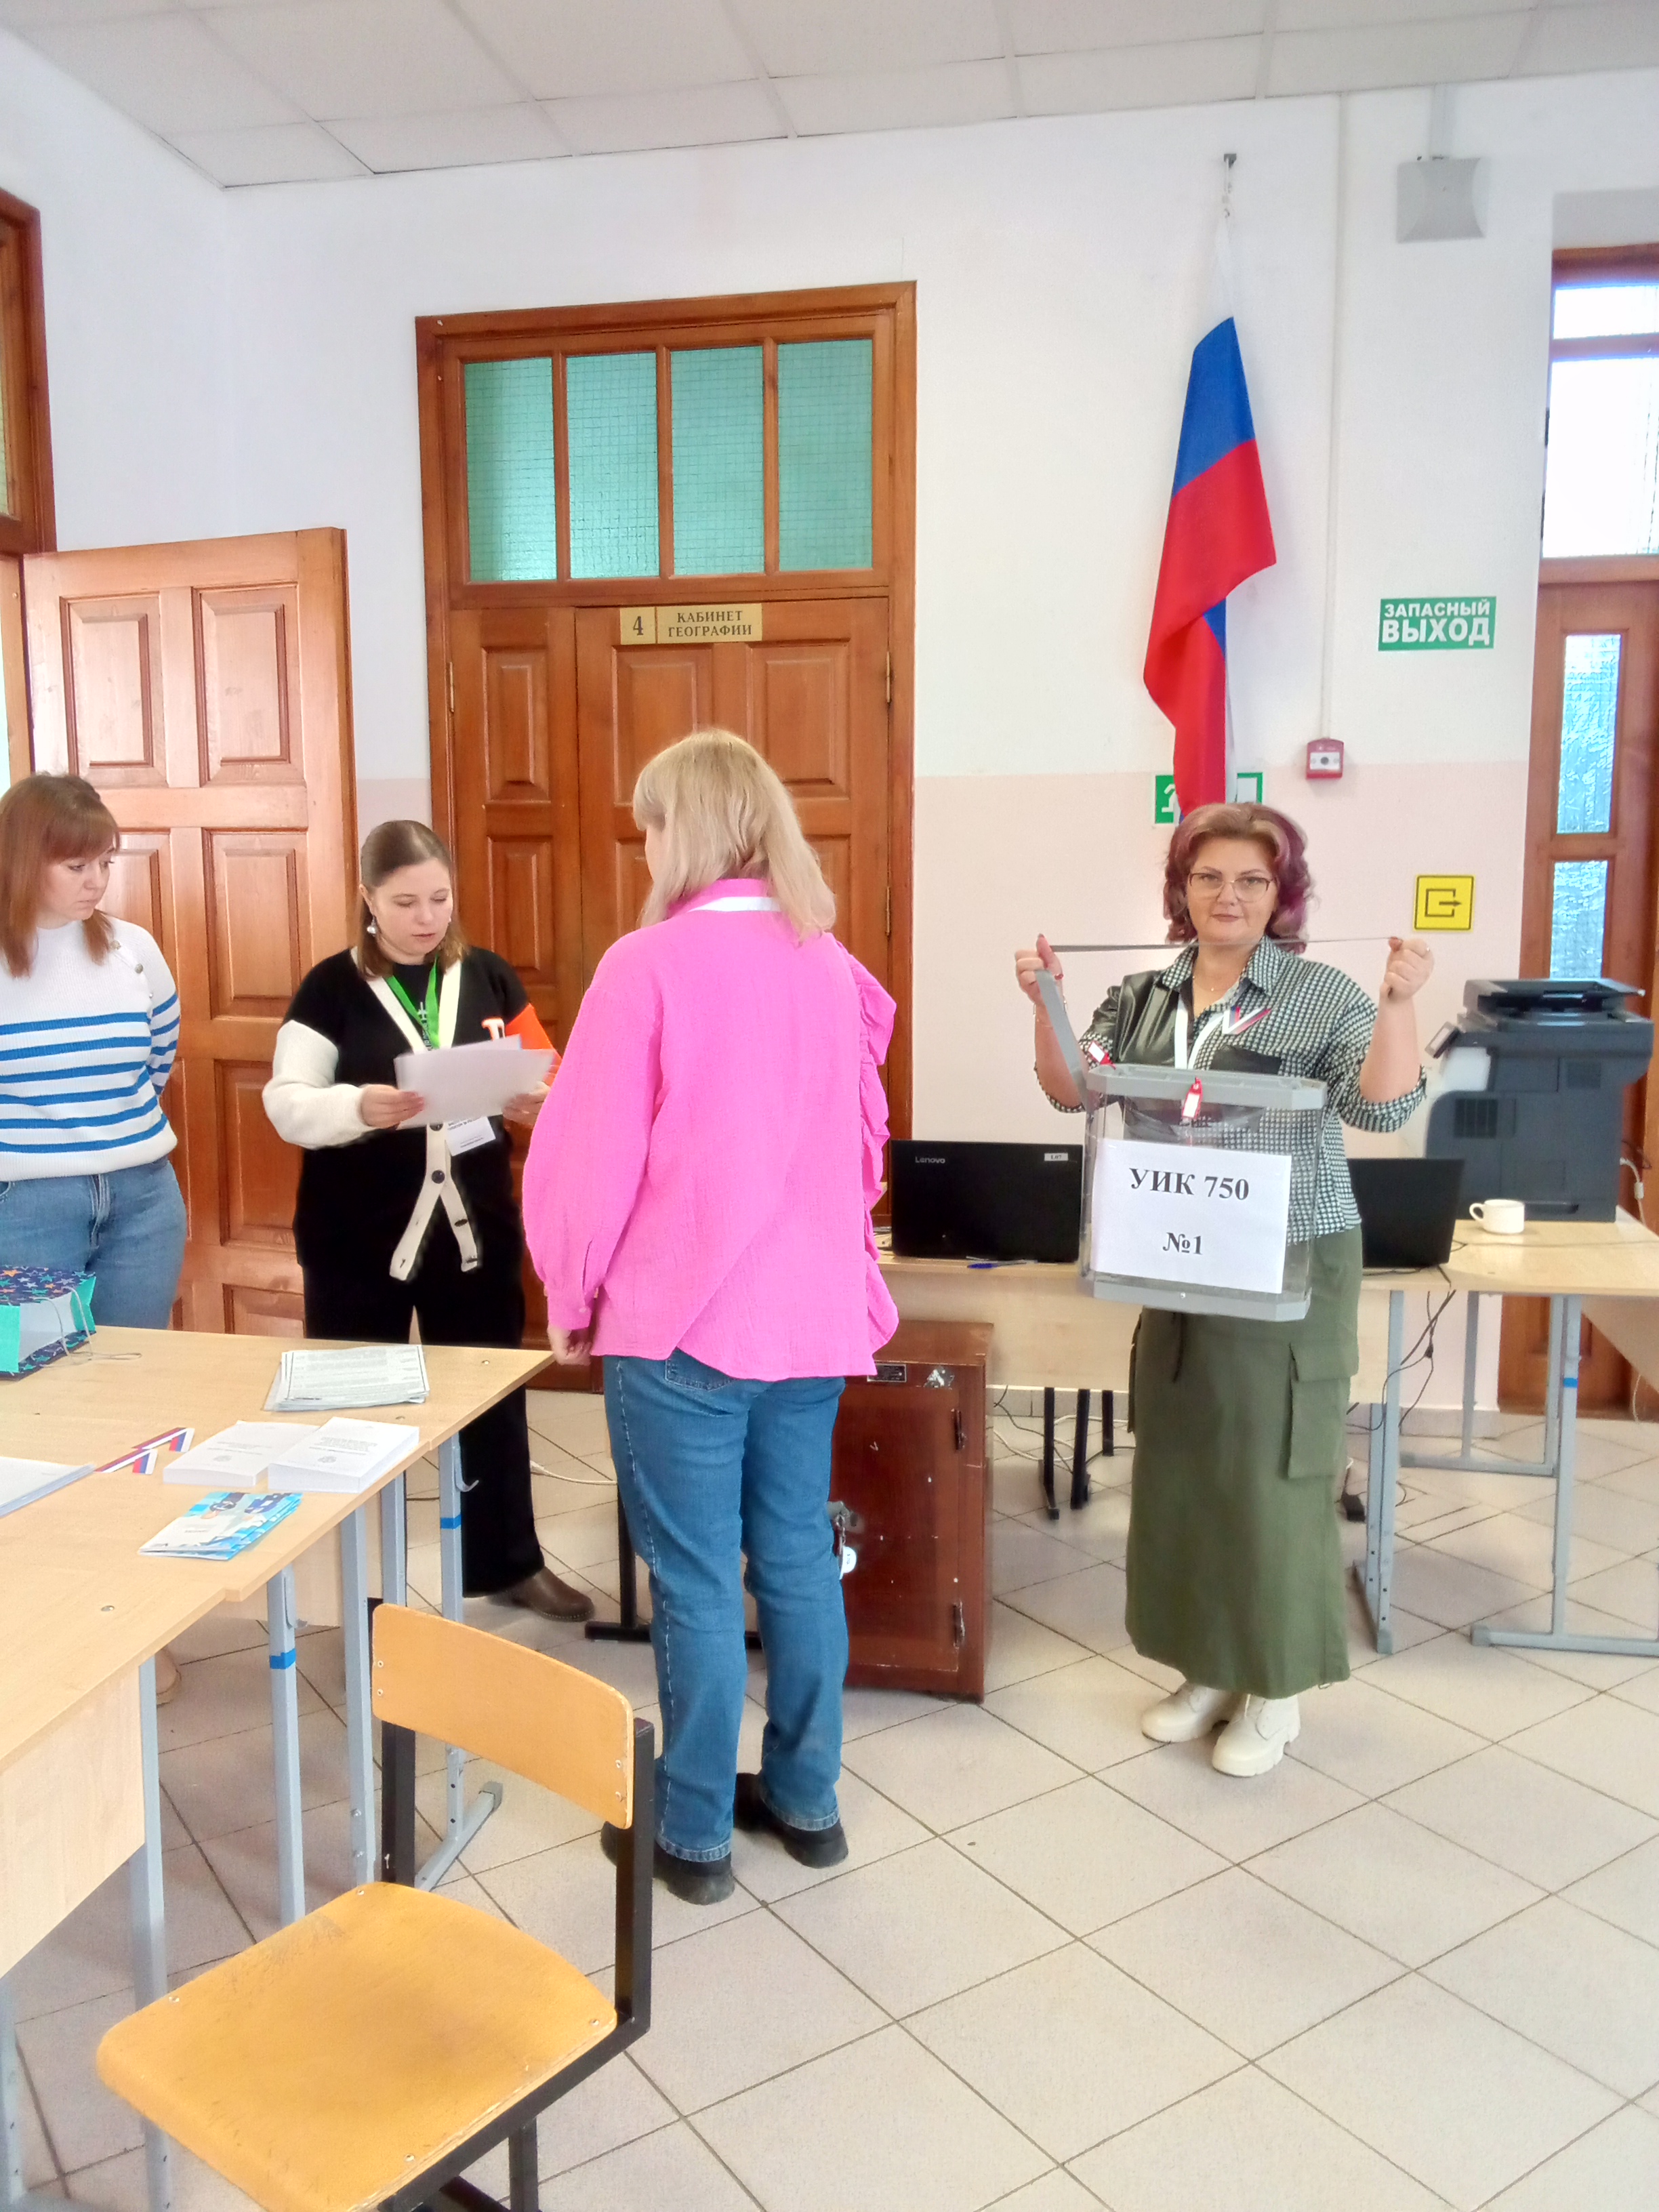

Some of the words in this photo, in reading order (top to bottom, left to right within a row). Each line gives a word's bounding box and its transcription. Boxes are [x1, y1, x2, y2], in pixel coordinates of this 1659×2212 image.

[678, 611, 743, 623] КАБИНЕТ
[1385, 598, 1490, 617] ЗАПАСНЫЙ
[633, 616, 644, 636] 4
[668, 625, 752, 637] ГЕОГРАФИИ
[1382, 617, 1490, 646] ВЫХОД
[1130, 1168, 1195, 1195] УИК
[1204, 1176, 1249, 1200] 750
[1163, 1232, 1203, 1254] №1
